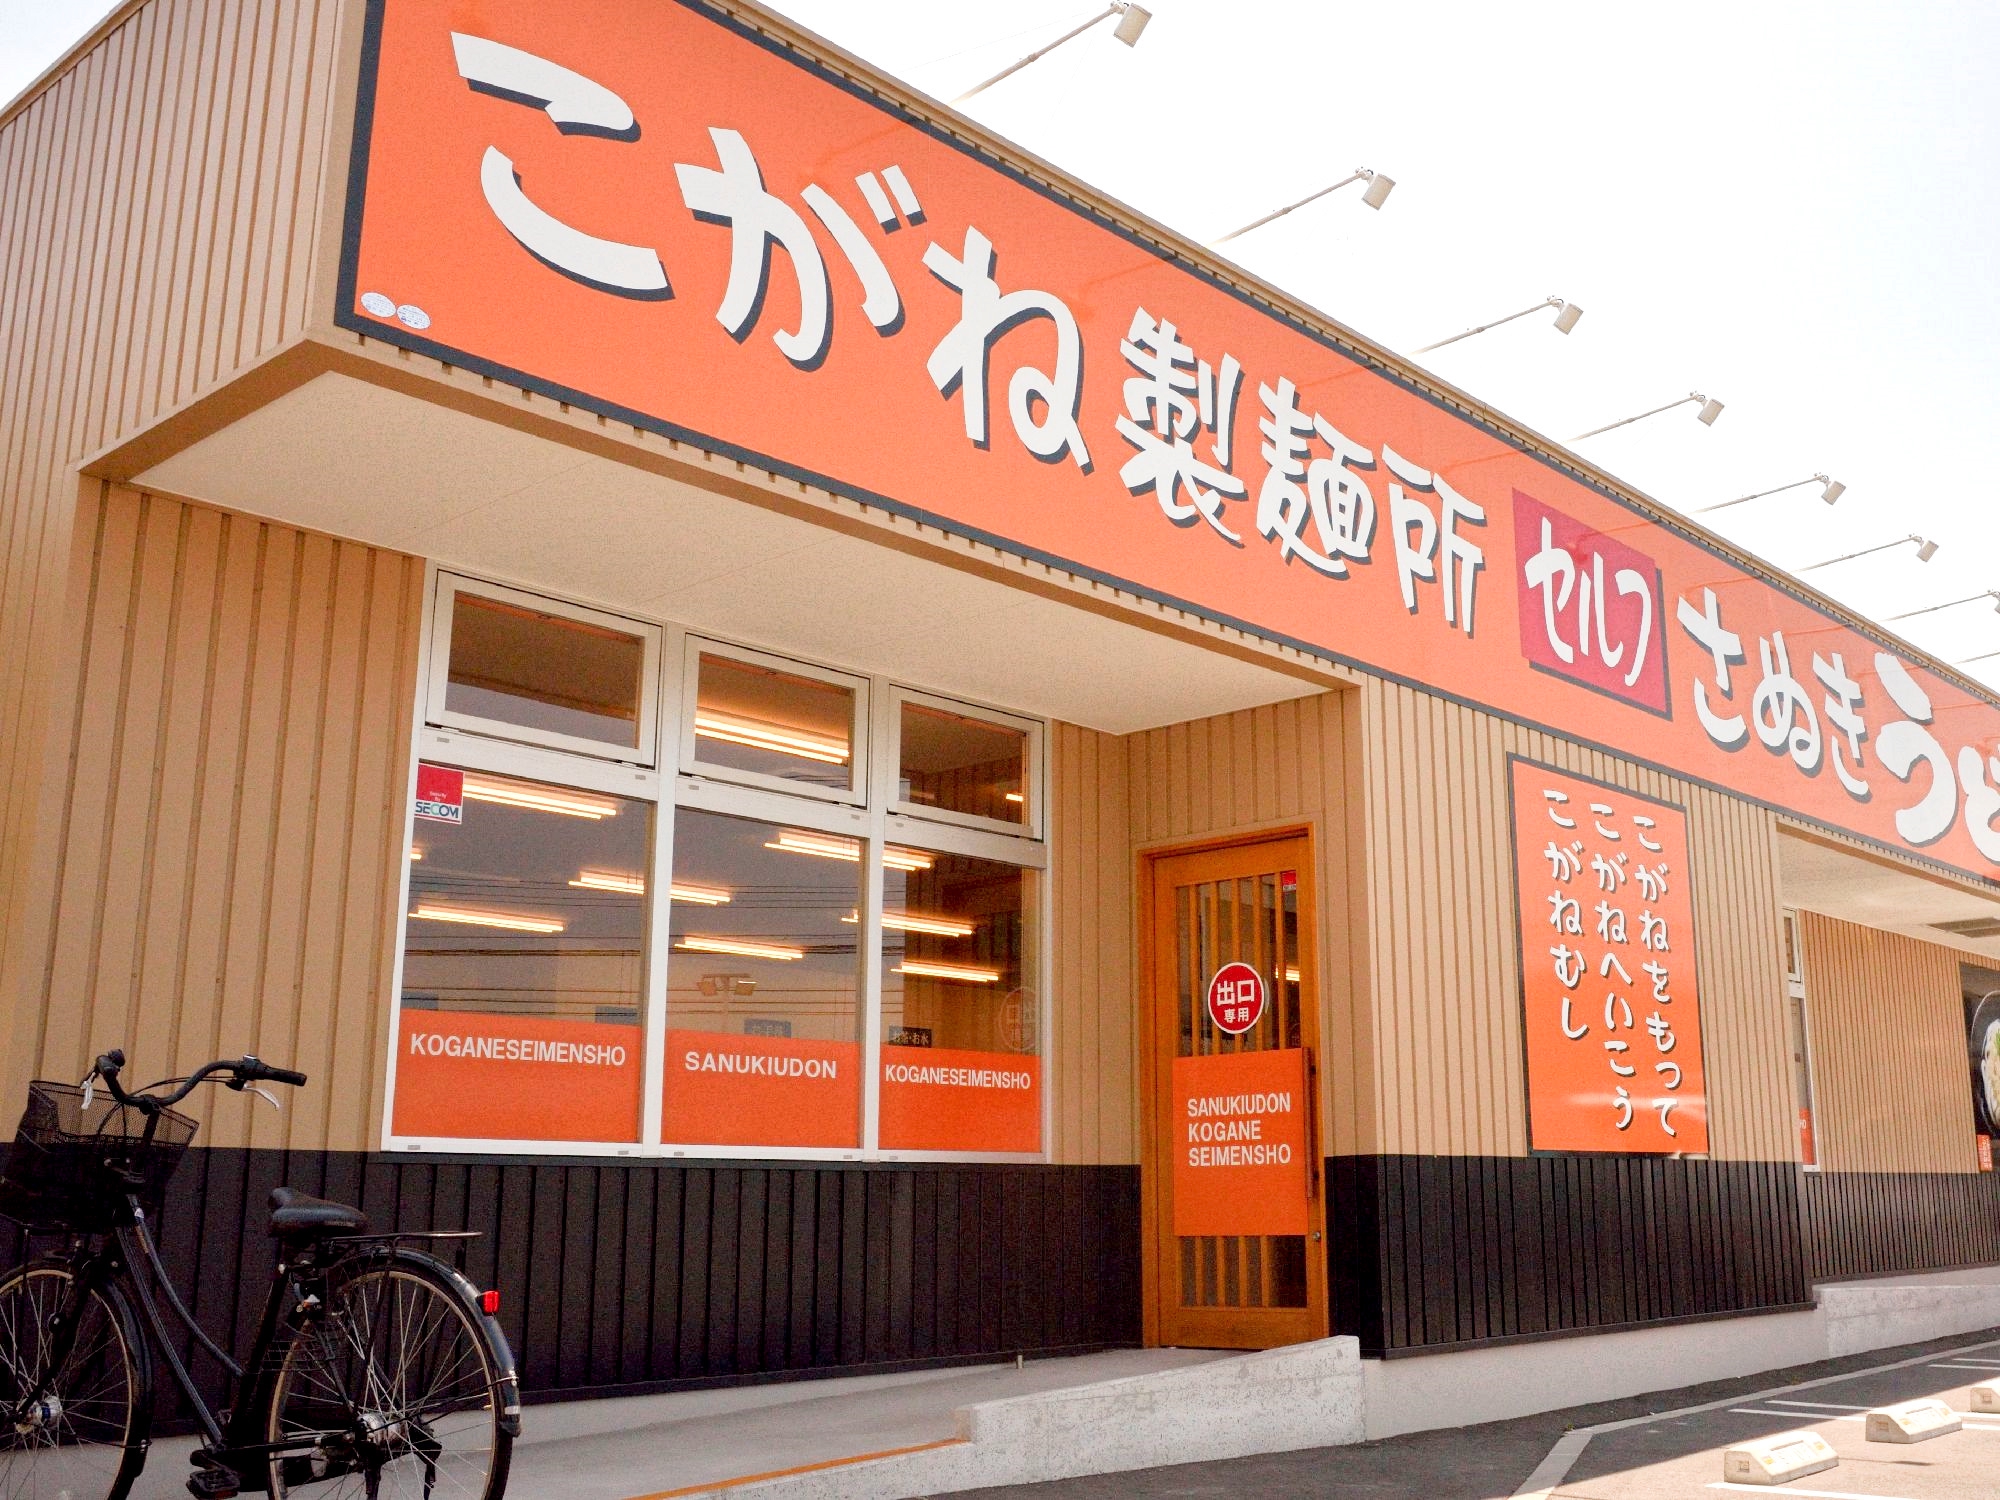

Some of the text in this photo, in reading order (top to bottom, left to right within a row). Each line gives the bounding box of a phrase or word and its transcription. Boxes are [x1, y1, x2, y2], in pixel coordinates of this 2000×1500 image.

[451, 31, 1487, 635] こがね製麺所
[1524, 516, 1652, 687] セルフ
[415, 801, 459, 818] SECOM
[1543, 788, 1590, 1041] こがねむし
[1589, 802, 1637, 1131] こがねへいこう
[1632, 814, 1682, 1138] こがねをもって
[1216, 979, 1255, 1006] 出口
[1224, 1007, 1249, 1023] 専用
[410, 1033, 626, 1067] KOGANESEIMENSHO
[684, 1051, 838, 1079] SANUKIUDON
[885, 1064, 1031, 1090] KOGANESEIMENSHO
[1187, 1092, 1291, 1117] SANUKIUDON
[1187, 1119, 1262, 1143] KOGANE
[1188, 1143, 1291, 1167] SEIMENSHO
